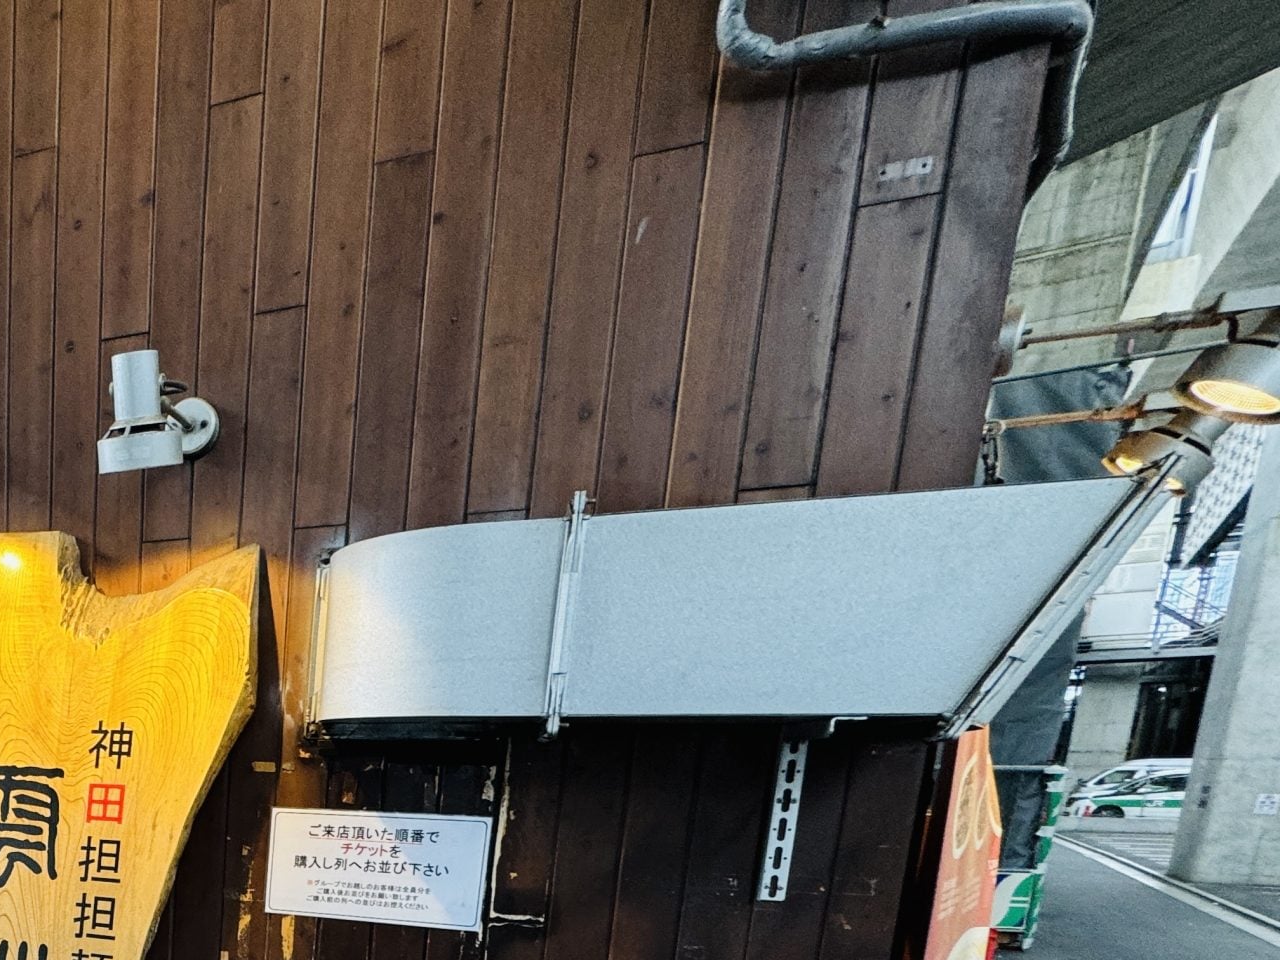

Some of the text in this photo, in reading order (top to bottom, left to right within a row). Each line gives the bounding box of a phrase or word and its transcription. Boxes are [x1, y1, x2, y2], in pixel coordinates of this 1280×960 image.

[308, 824, 440, 844] ご来店頂いた順番で
[340, 843, 402, 859] チケットを
[294, 855, 449, 877] 購入し列へお並び下さい
